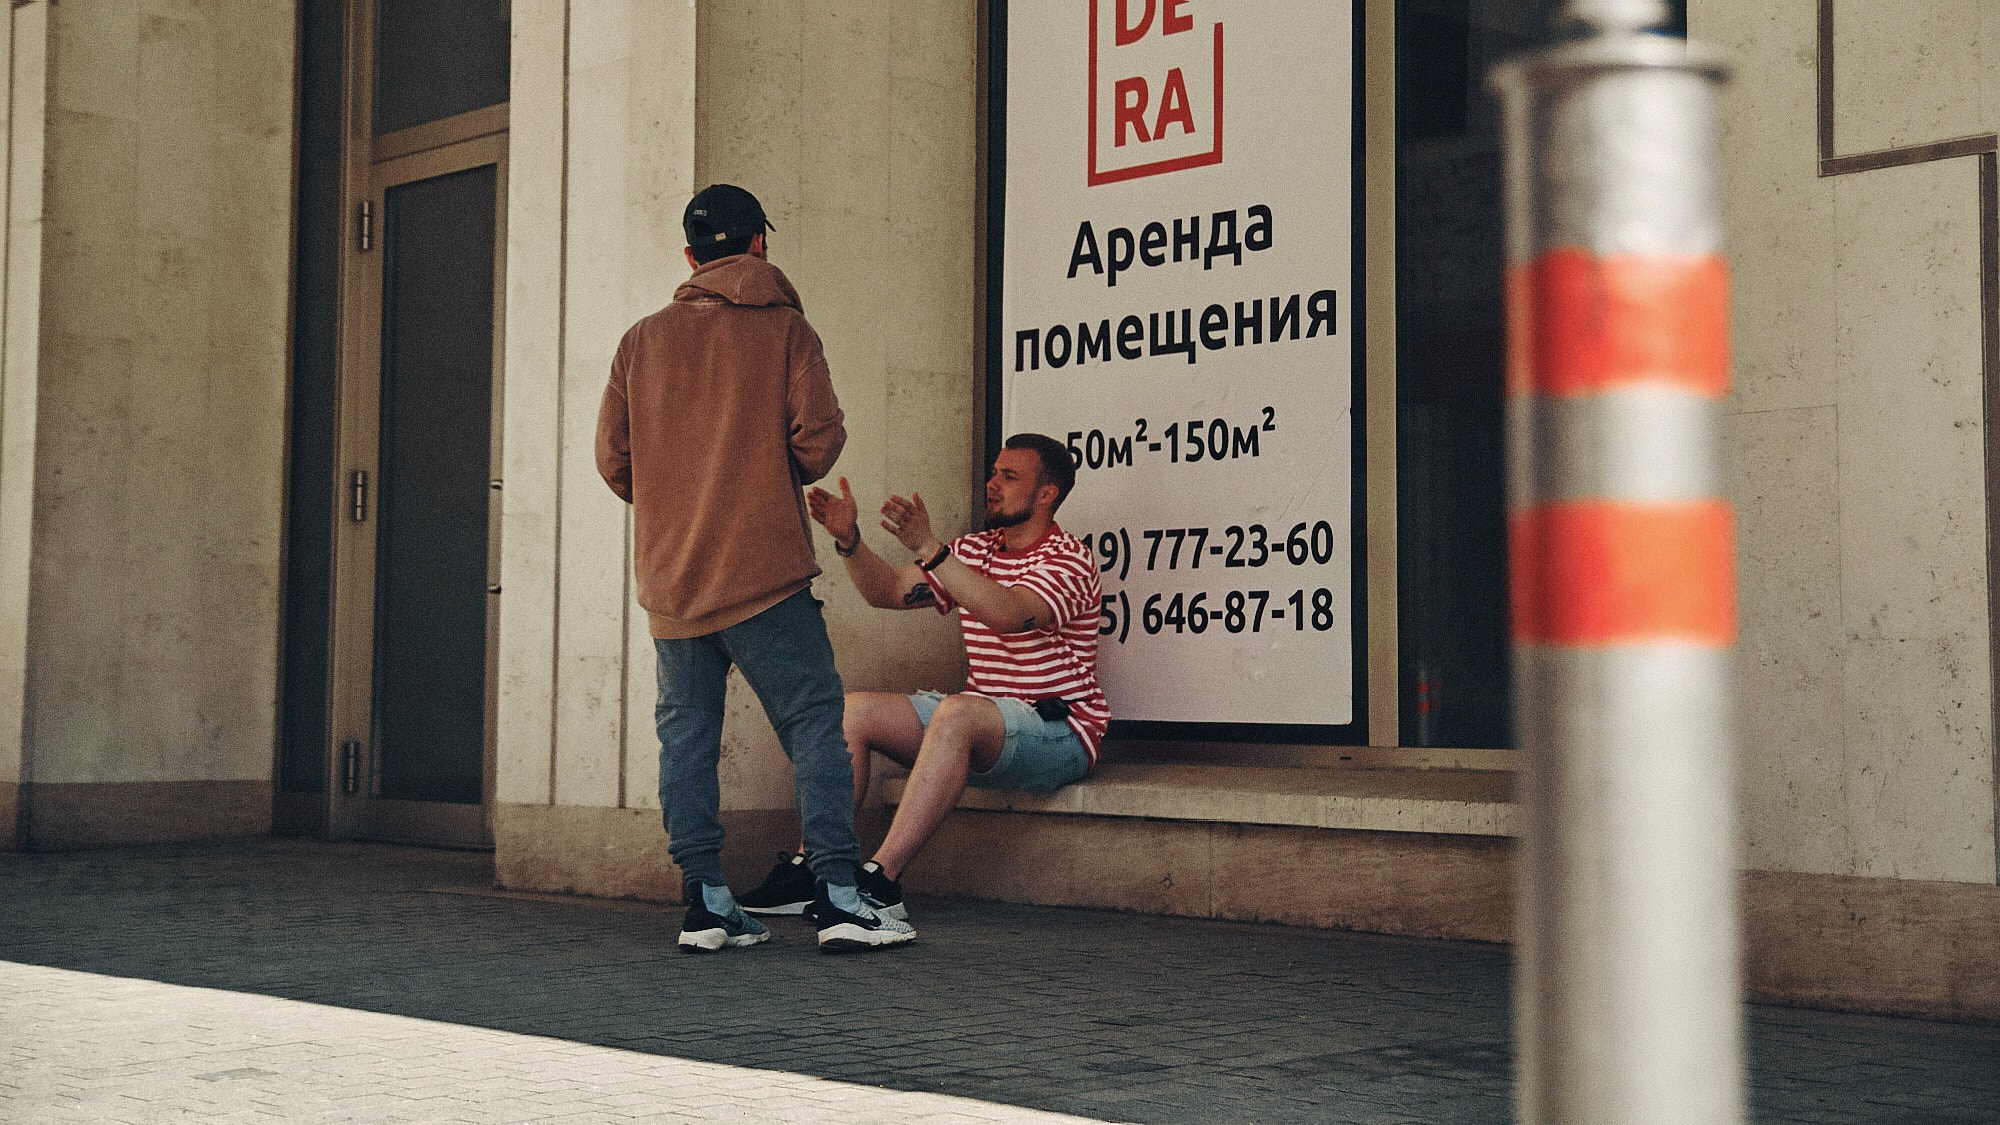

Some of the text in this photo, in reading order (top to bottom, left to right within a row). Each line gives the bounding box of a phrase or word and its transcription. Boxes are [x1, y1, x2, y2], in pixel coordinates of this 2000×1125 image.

[1114, 67, 1196, 148] RA
[1066, 204, 1273, 287] Аренда
[1014, 289, 1337, 373] помещения
[1143, 520, 1334, 572] 777-23-60
[1142, 587, 1334, 636] 646-87-18
